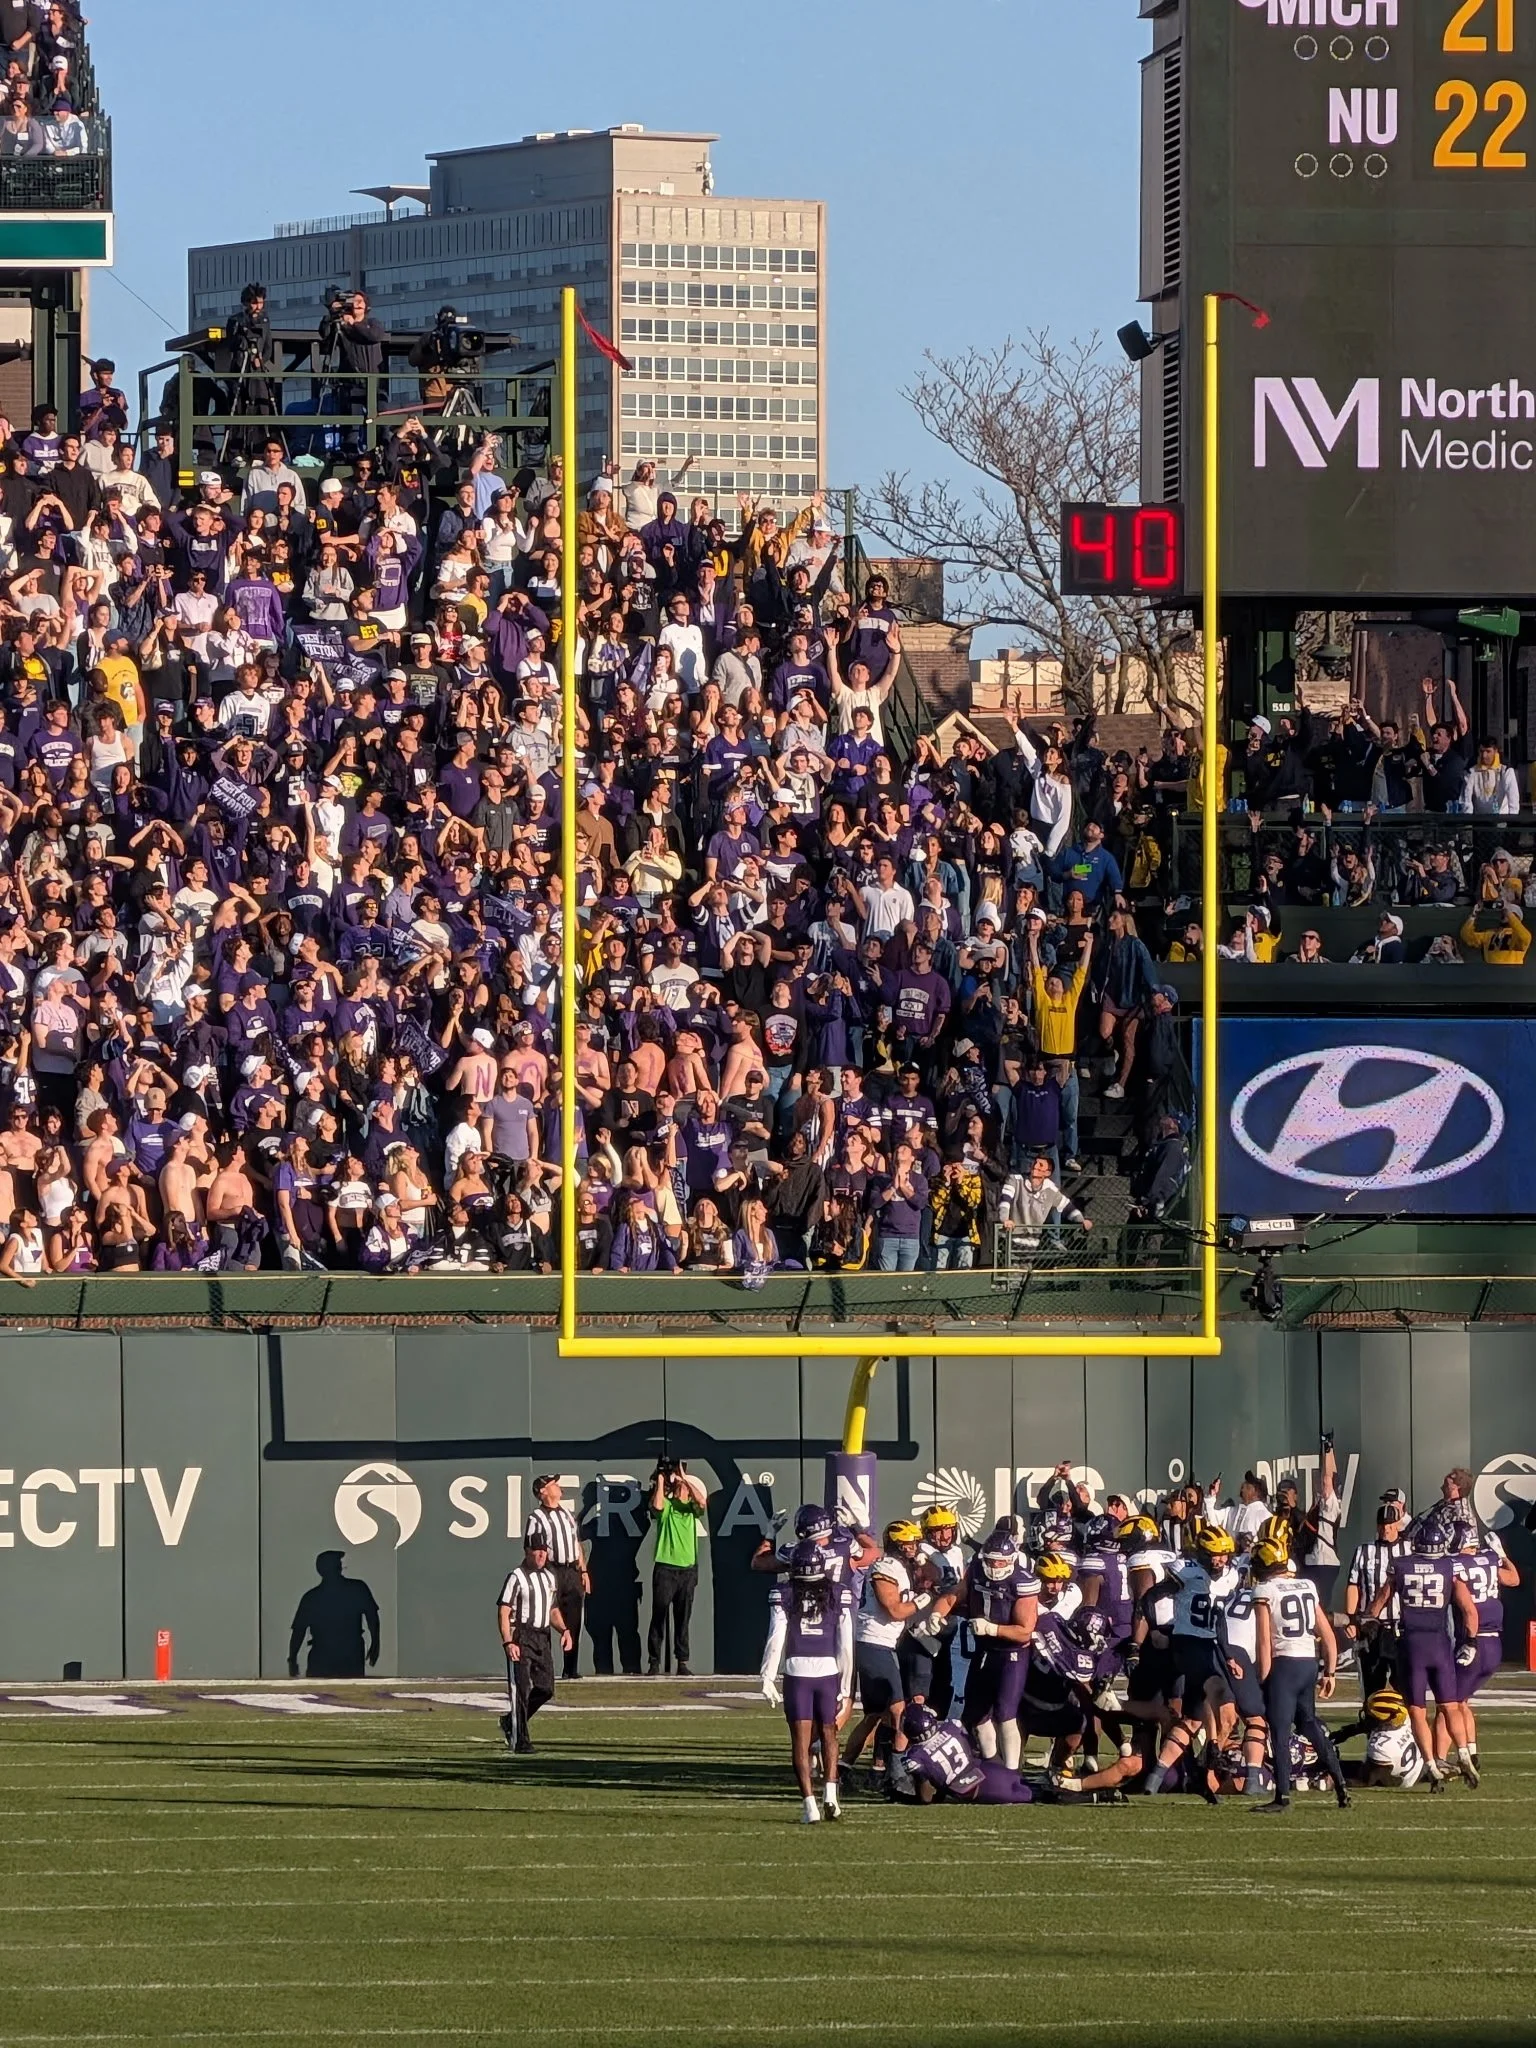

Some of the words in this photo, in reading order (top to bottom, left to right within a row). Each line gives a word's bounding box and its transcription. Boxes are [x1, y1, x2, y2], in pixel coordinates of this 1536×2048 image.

[1443, 0, 1514, 52] 21
[1328, 87, 1398, 145] NU
[1433, 79, 1527, 168] 22
[1401, 377, 1535, 418] North
[1401, 428, 1535, 470] Medic
[1072, 510, 1175, 585] 40
[836, 1475, 870, 1527] N
[1403, 1573, 1445, 1609] 33
[1469, 1565, 1499, 1604] 34
[1280, 1592, 1317, 1638] 90
[930, 1736, 971, 1786] 13
